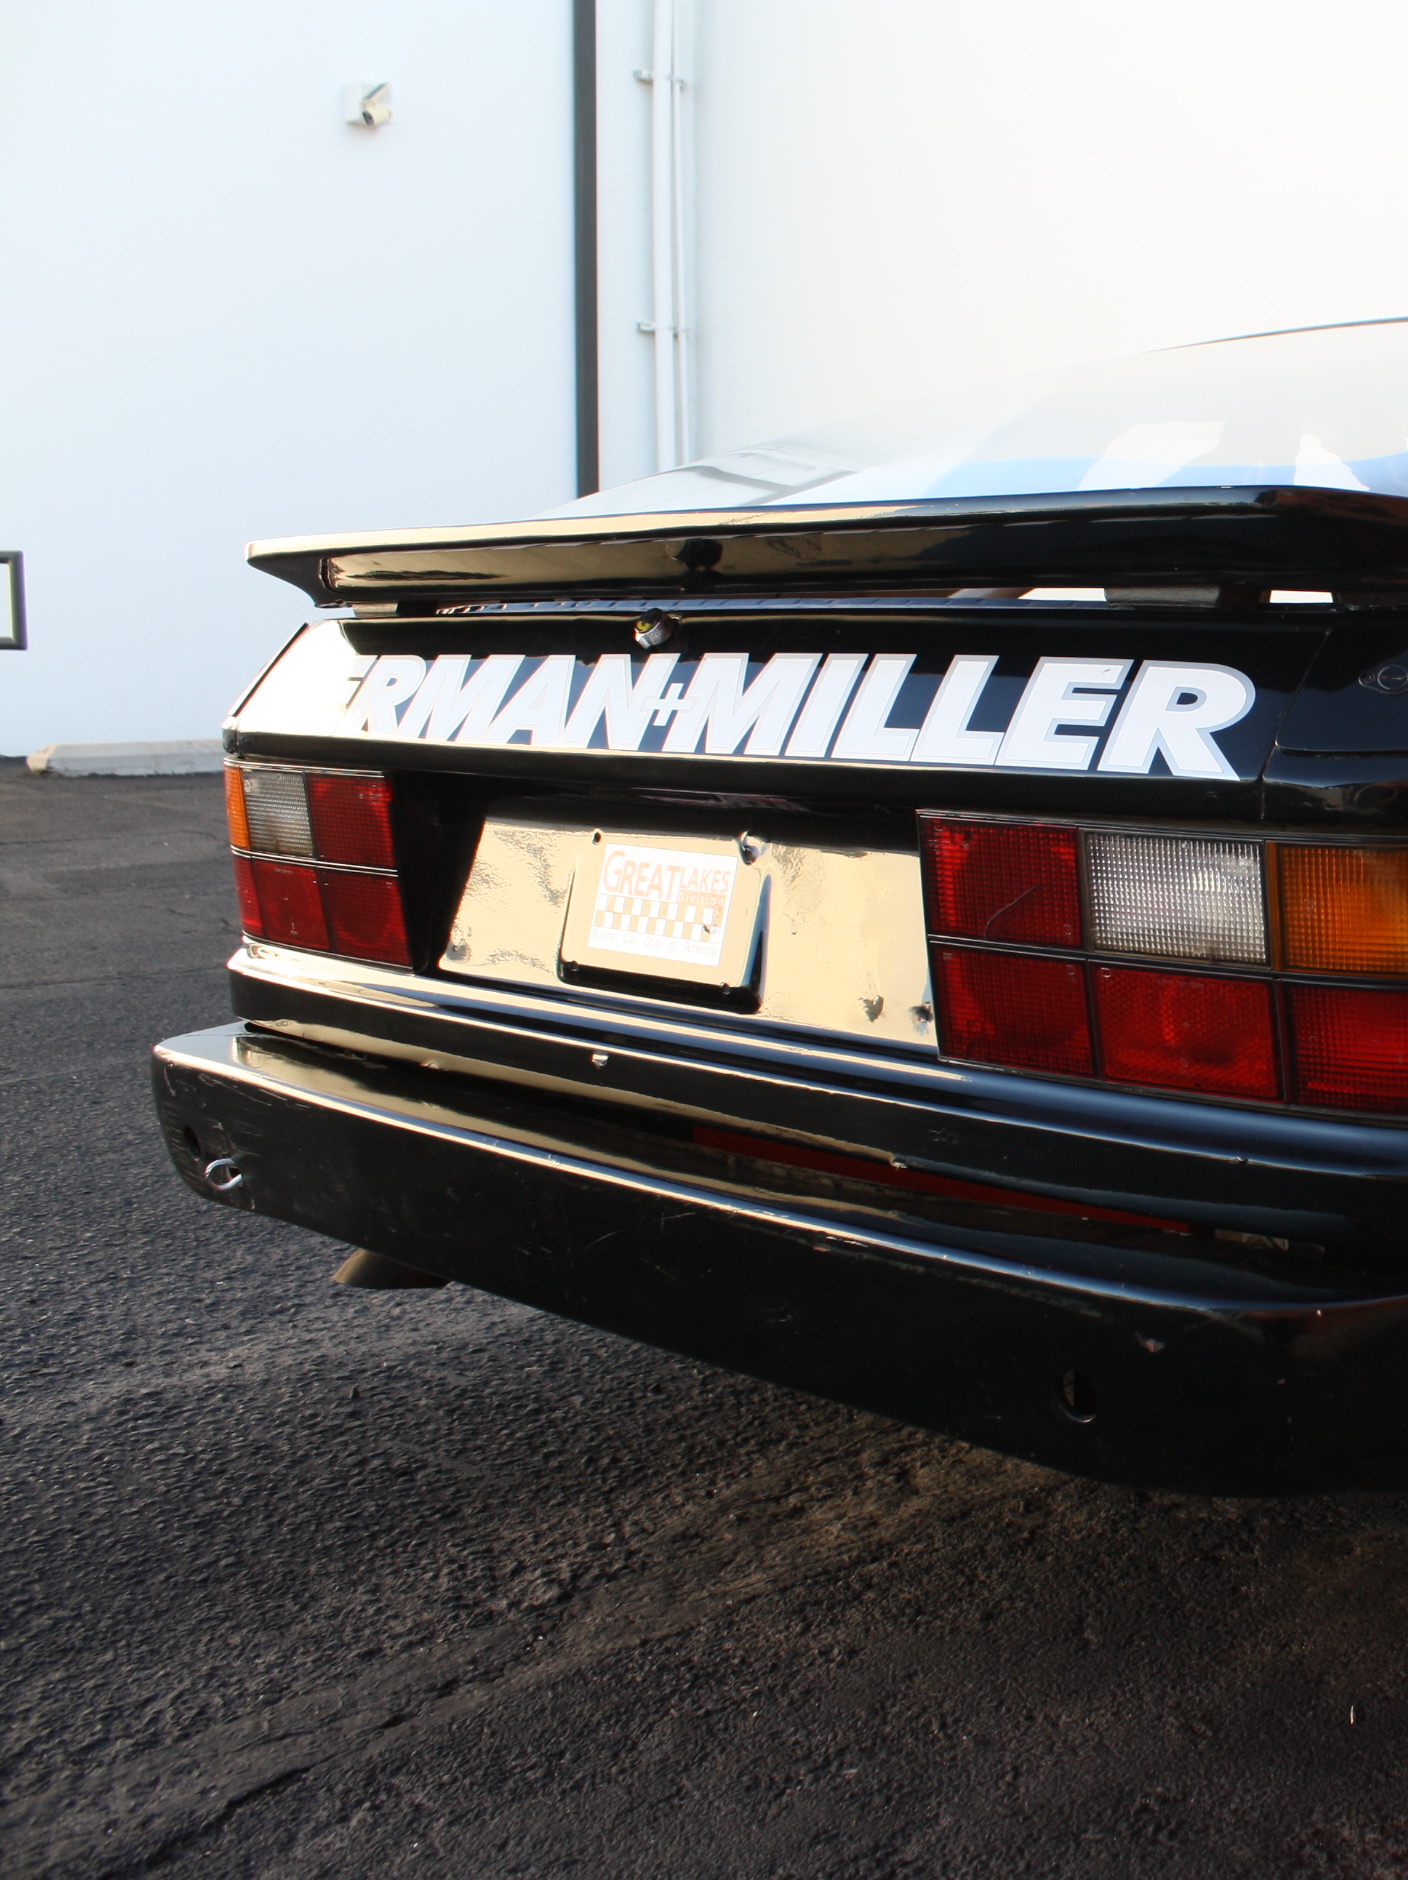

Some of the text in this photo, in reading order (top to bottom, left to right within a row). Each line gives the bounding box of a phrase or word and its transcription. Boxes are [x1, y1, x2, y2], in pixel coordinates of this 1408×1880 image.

[679, 866, 731, 894] LAKES
[623, 933, 637, 944] Car
[644, 936, 663, 948] Club
[685, 942, 717, 957] America
